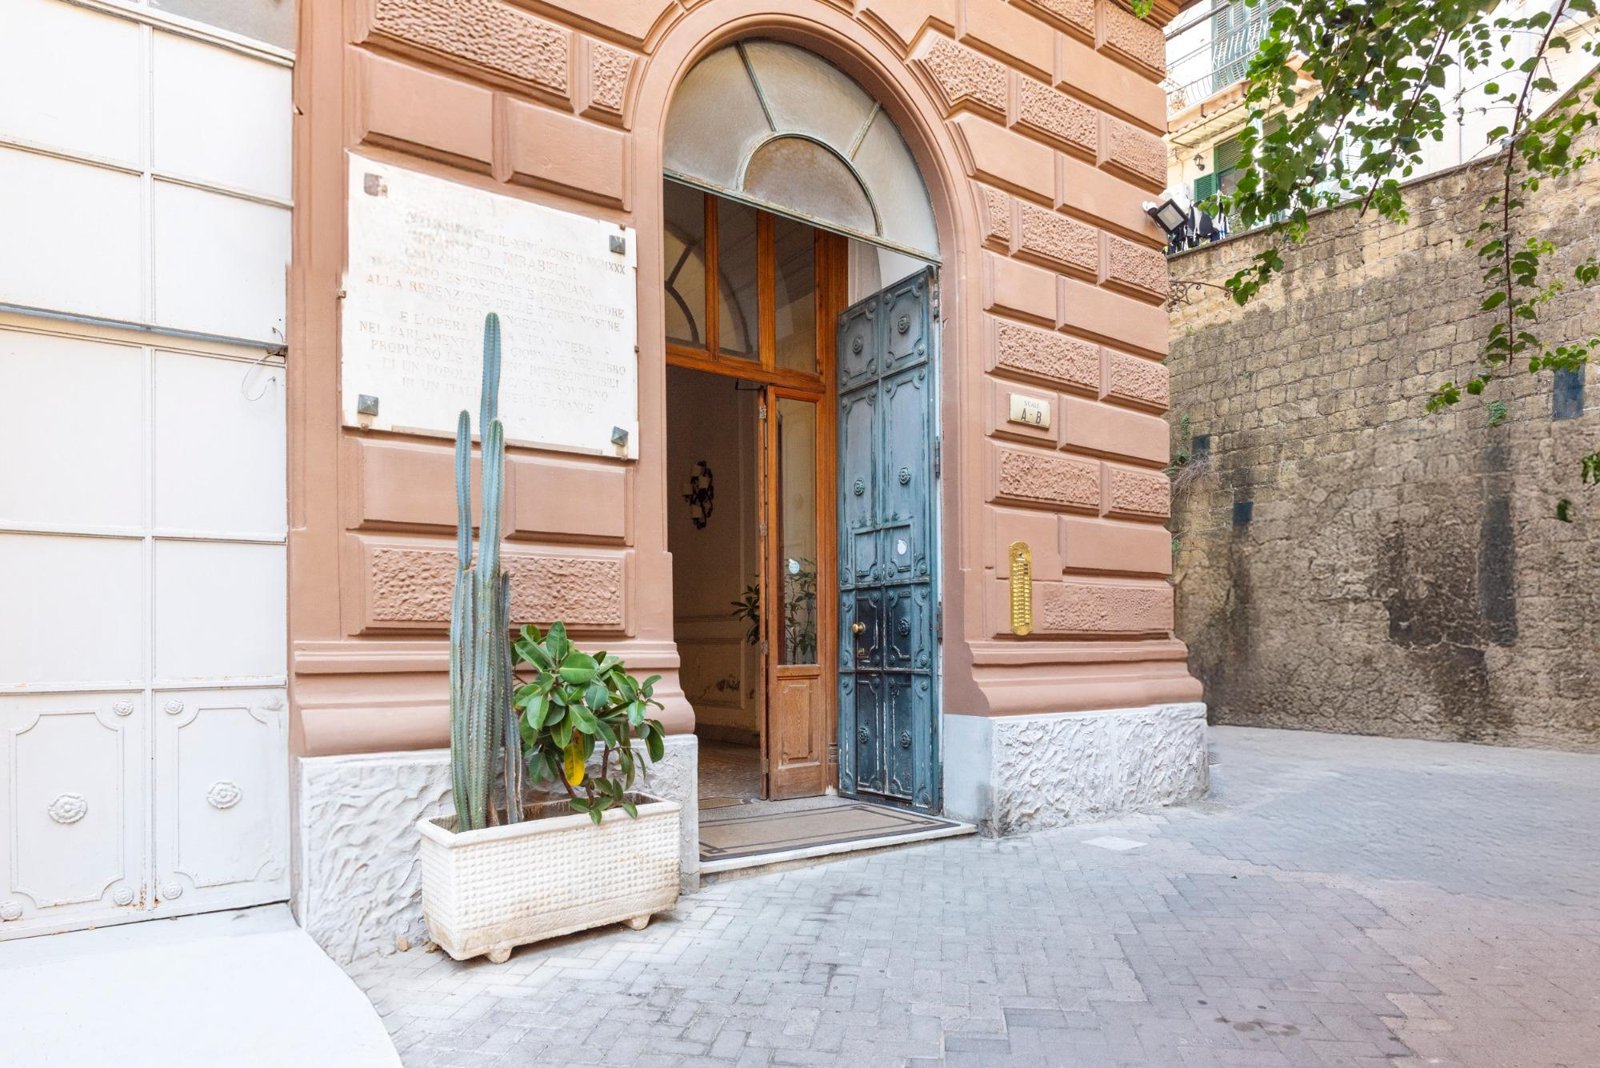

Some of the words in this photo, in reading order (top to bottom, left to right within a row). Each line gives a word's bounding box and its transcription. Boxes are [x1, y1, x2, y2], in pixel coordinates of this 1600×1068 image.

[503, 251, 576, 280] MIRABELLI
[366, 271, 402, 290] ALLA
[408, 279, 490, 307] REDENZIONE
[496, 297, 534, 316] DELLE
[358, 319, 383, 336] NEL
[1020, 407, 1027, 421] A
[1035, 411, 1042, 424] B
